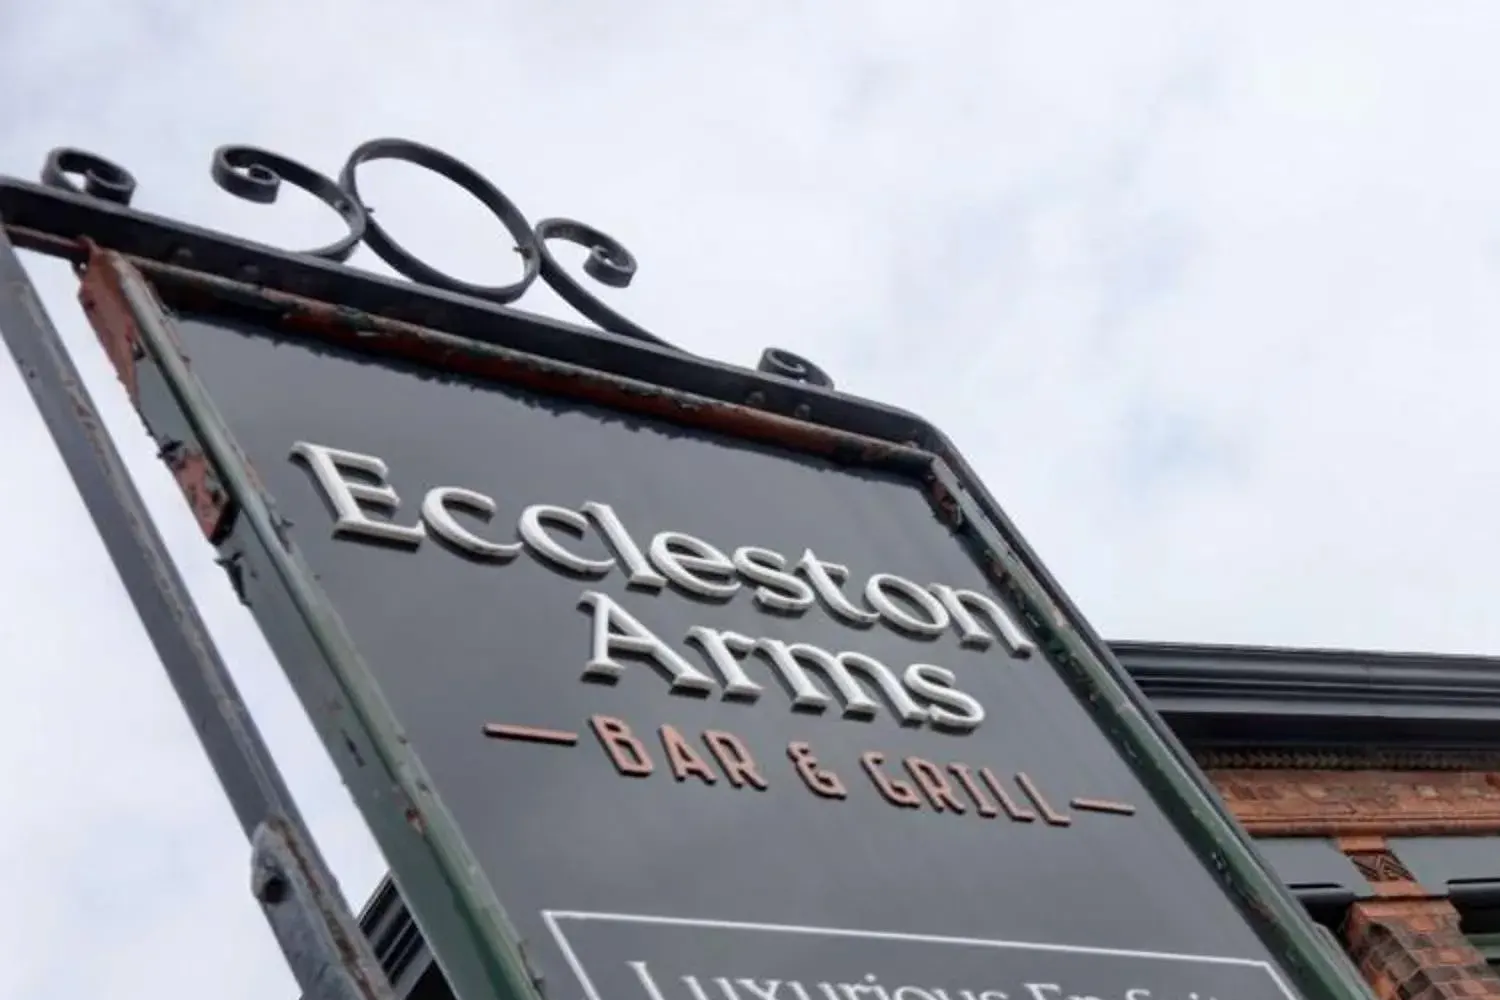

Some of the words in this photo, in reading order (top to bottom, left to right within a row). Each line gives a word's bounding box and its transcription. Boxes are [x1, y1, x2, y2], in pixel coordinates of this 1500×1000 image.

[289, 440, 1035, 657] Eccleston
[578, 590, 985, 732] Arms
[588, 715, 768, 789] BAR
[786, 741, 849, 798] &
[861, 749, 1071, 826] GRILL
